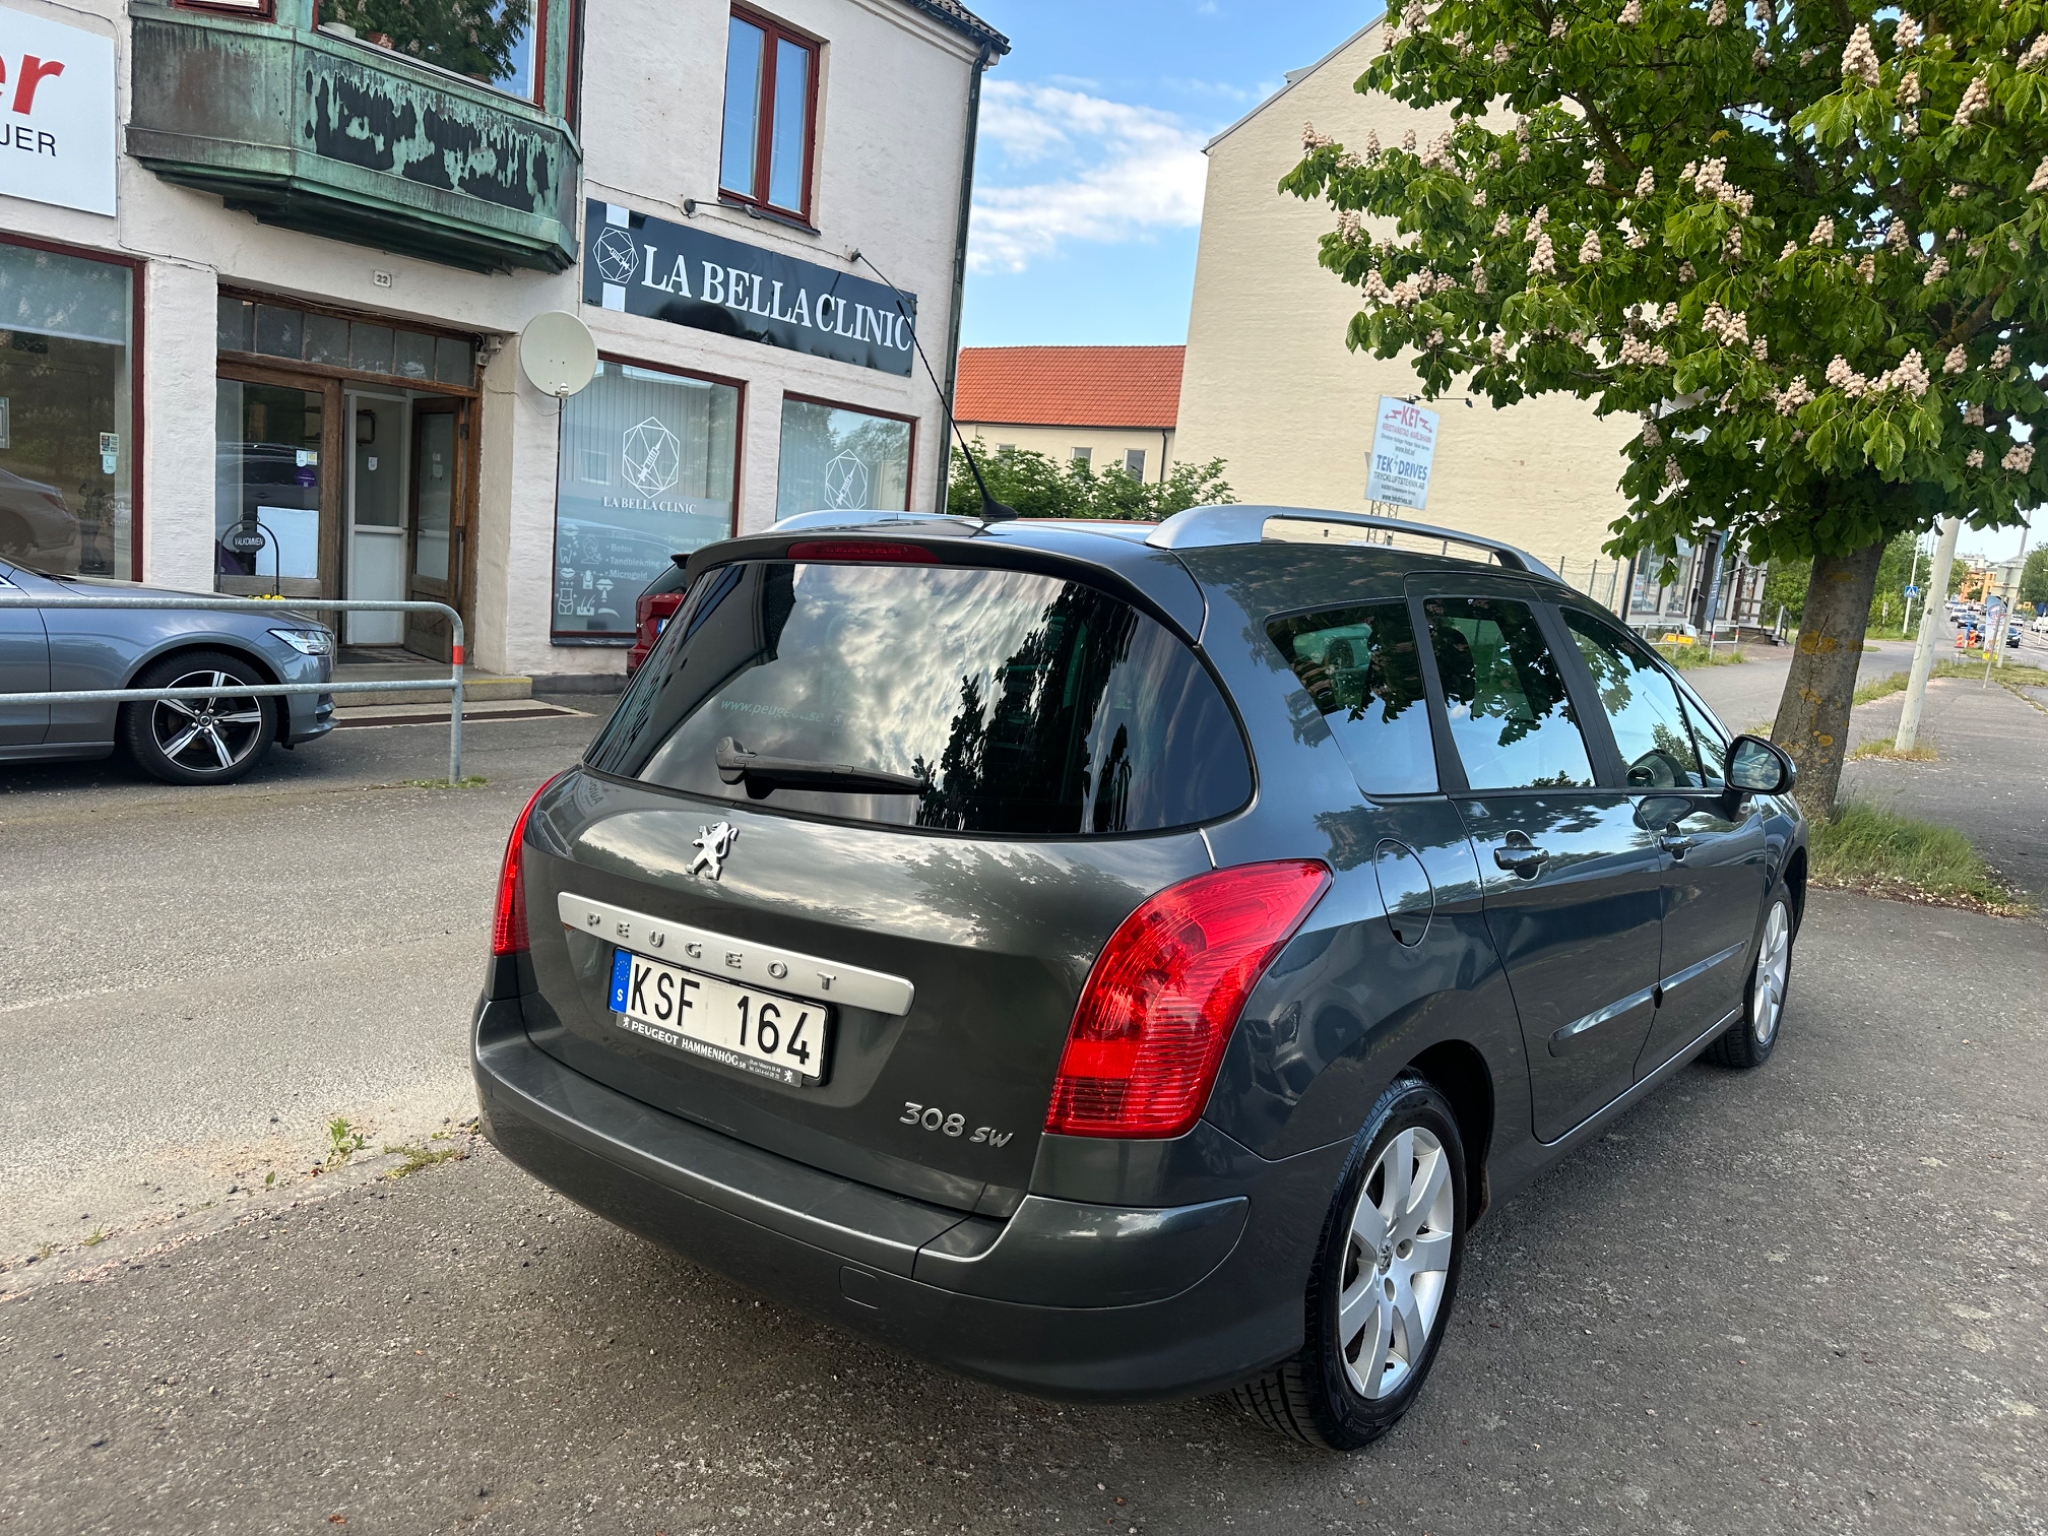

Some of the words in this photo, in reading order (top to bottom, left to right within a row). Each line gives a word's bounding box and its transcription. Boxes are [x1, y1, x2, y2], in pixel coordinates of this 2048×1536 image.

[0, 54, 65, 115] r
[376, 274, 389, 285] 22
[641, 244, 692, 298] LA
[1400, 405, 1420, 429] KET
[1376, 454, 1394, 473] TEK
[1398, 460, 1427, 481] DRIVES
[603, 496, 619, 508] LA
[621, 498, 657, 511] BELLA
[659, 500, 697, 514] CLINIC
[610, 543, 633, 553] Botox
[610, 556, 660, 568] Tandblekning
[609, 569, 648, 581] Microgold
[587, 912, 837, 990] PEUGEOT
[616, 989, 623, 1002] S
[631, 963, 700, 1026] KSF
[737, 995, 810, 1065] 164
[631, 1020, 679, 1046] PEUGEOT
[899, 1101, 966, 1137] 308
